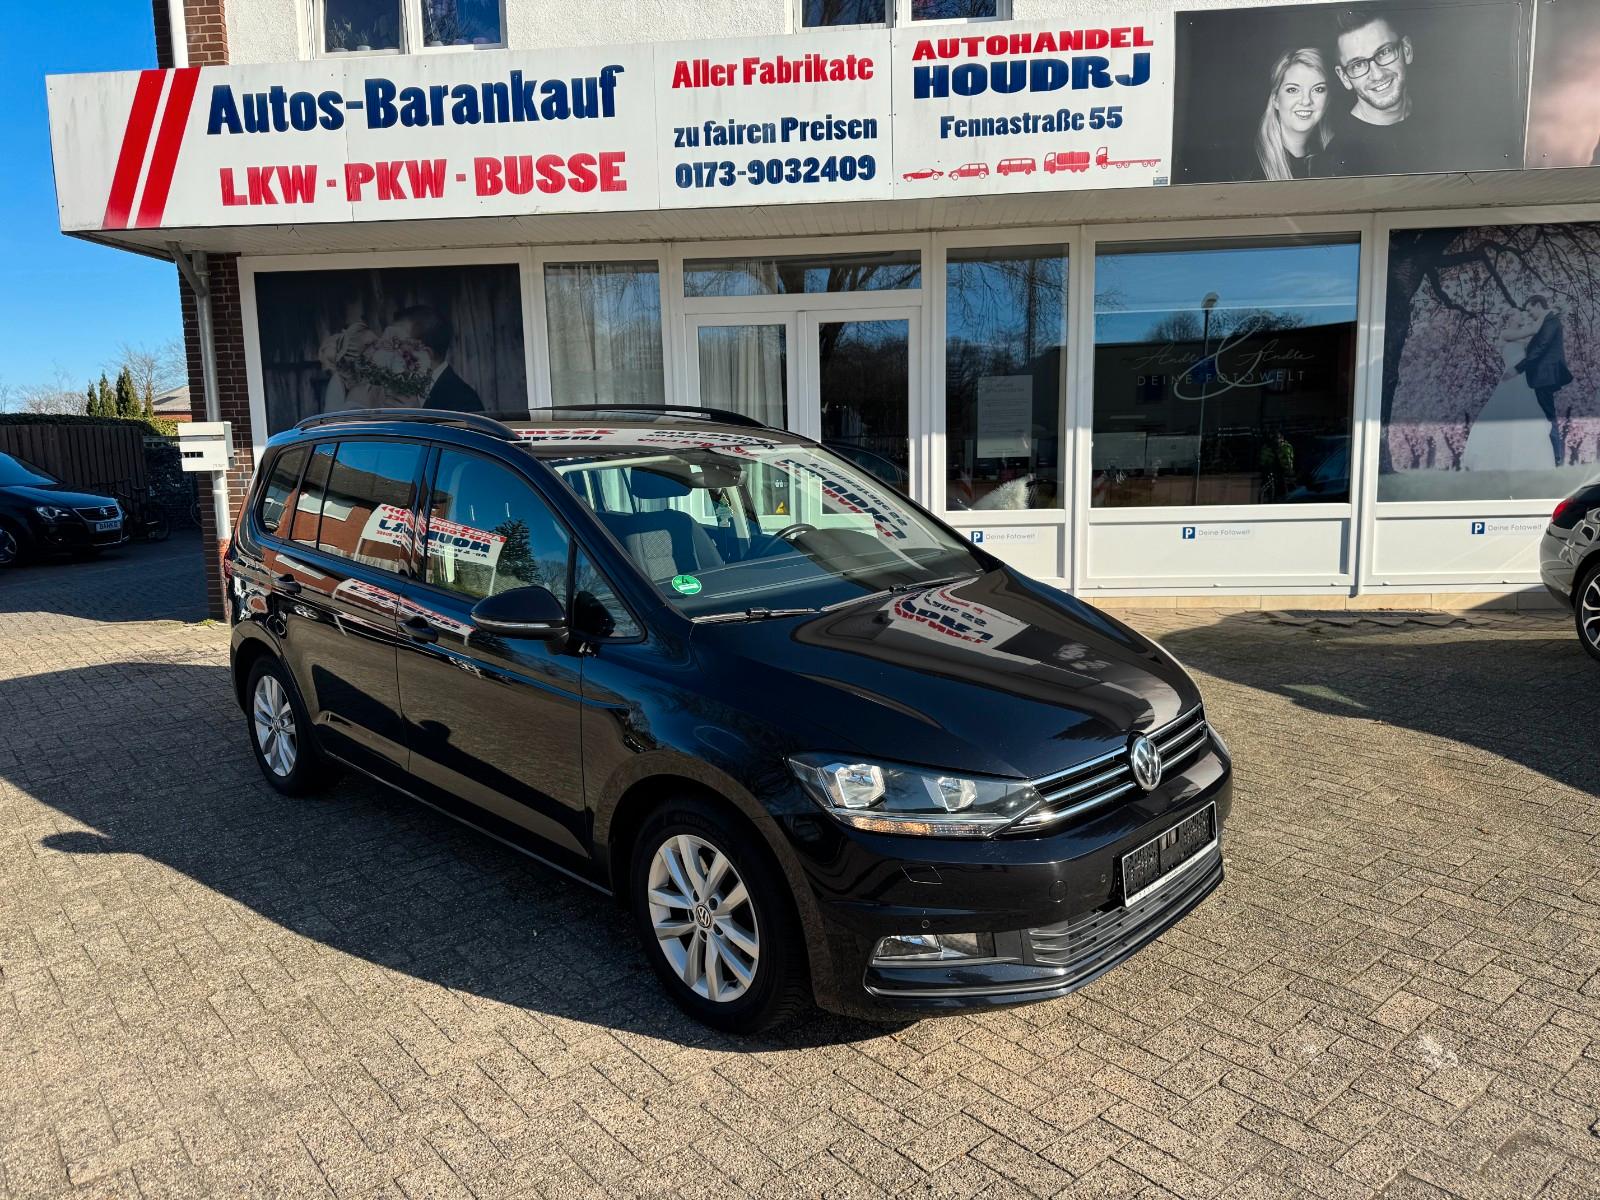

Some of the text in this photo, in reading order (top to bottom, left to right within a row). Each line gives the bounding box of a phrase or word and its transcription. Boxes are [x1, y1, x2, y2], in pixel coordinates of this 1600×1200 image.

[913, 26, 1152, 61] AUTOHANDEL
[672, 54, 874, 88] Aller Fabrikate
[914, 53, 1151, 99] HOUDRJ
[207, 65, 625, 135] Autos-Barankauf
[674, 115, 877, 147] zu fairen Preisen
[940, 106, 1123, 139] Fennastraße 55
[220, 152, 627, 206] LKW PKW BUSSE
[675, 154, 876, 189] 0173-9032409
[1137, 371, 1305, 386] DEINE FOTOWELT
